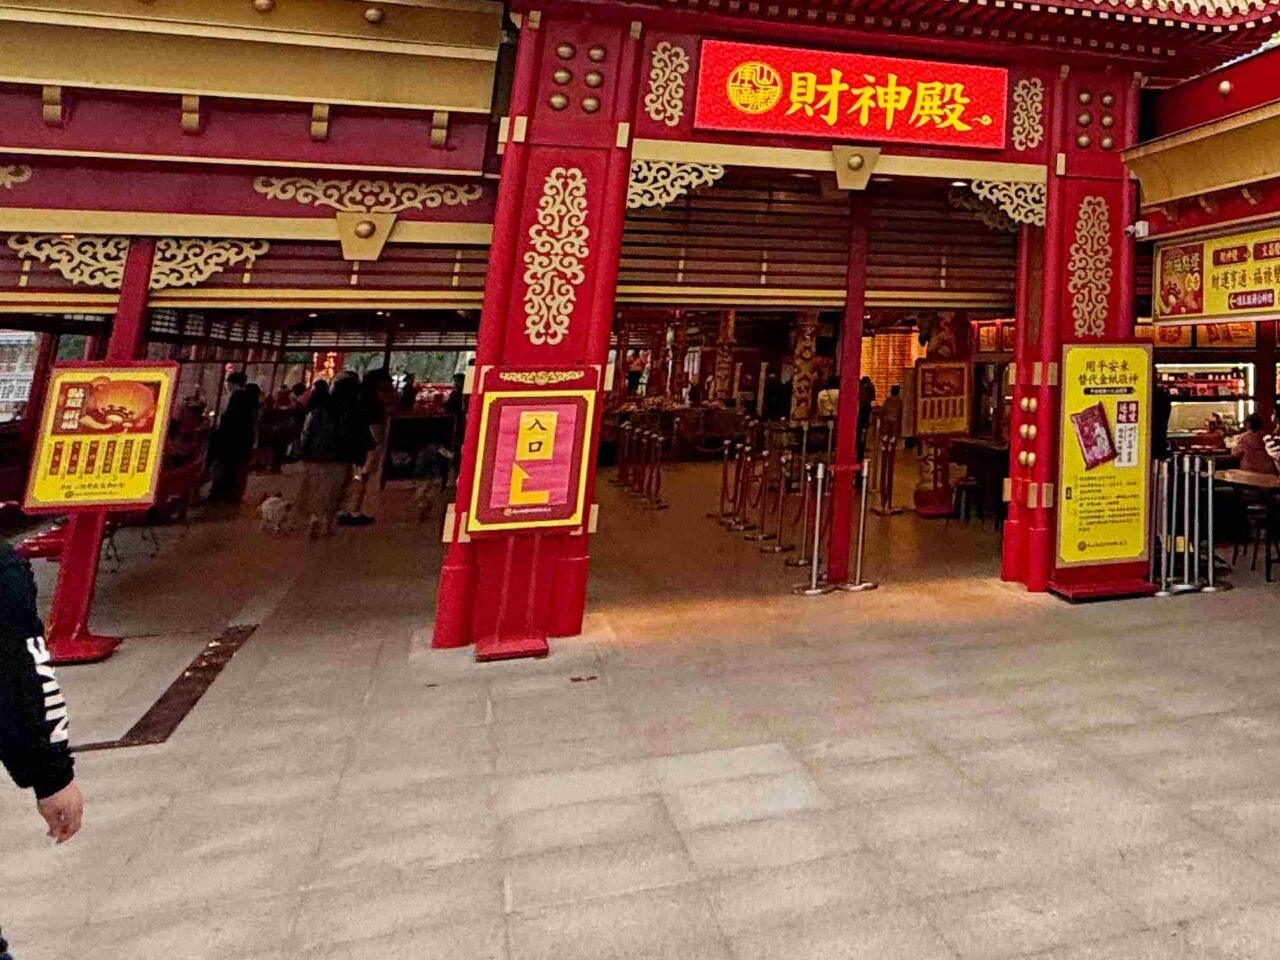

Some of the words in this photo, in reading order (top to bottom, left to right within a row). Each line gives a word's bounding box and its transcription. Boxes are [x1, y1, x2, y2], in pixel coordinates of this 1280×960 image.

[785, 68, 972, 131] 財神殿
[528, 418, 547, 453] 入口
